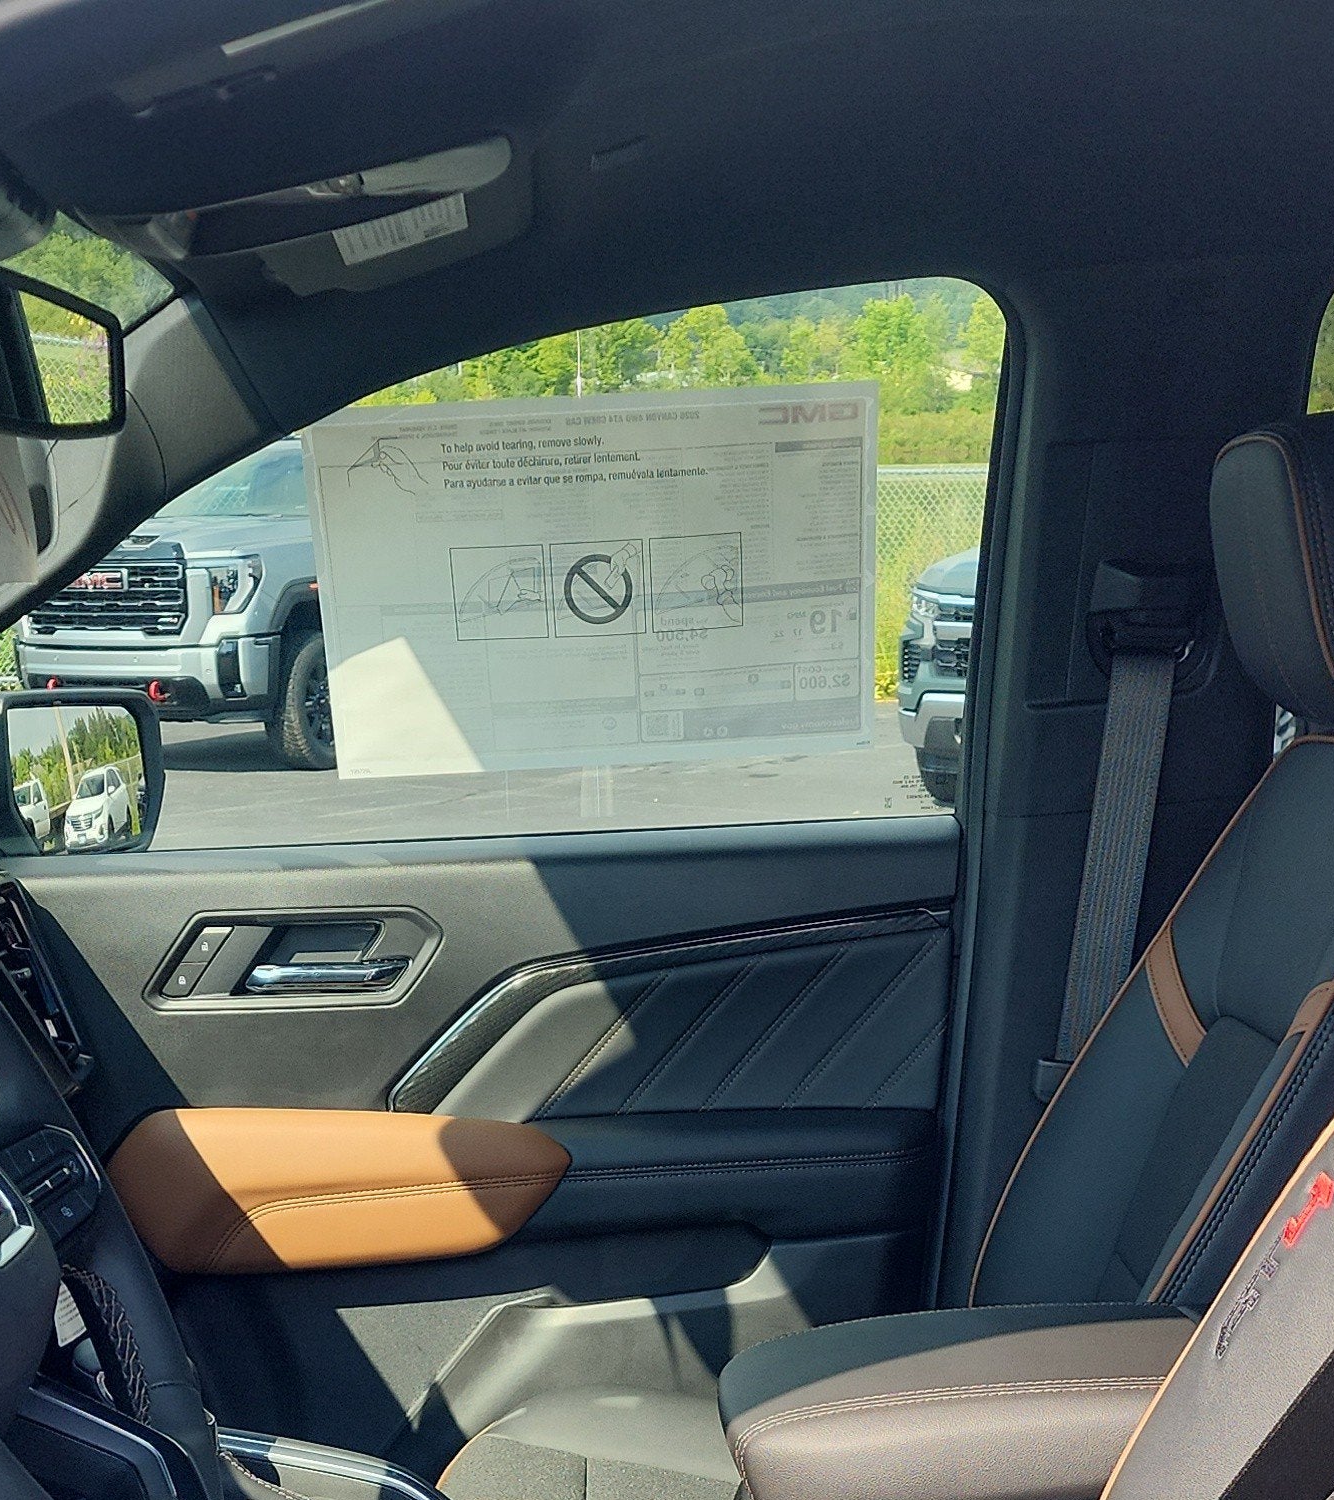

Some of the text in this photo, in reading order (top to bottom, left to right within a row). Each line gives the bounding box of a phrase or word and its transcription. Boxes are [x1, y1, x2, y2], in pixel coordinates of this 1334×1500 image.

[441, 435, 605, 454] To help avoid tearing, remove slowly.
[442, 461, 463, 471] Pour
[465, 459, 490, 470] éviter
[492, 458, 516, 469] toute
[564, 454, 591, 465] retirer
[444, 478, 465, 489] Para
[466, 477, 507, 490] ayudarse
[516, 476, 542, 487] evitar
[543, 475, 561, 487] que
[562, 475, 574, 484] se
[575, 473, 607, 485] rompa,
[608, 468, 654, 481] remuévala
[656, 465, 709, 478] lentamente.
